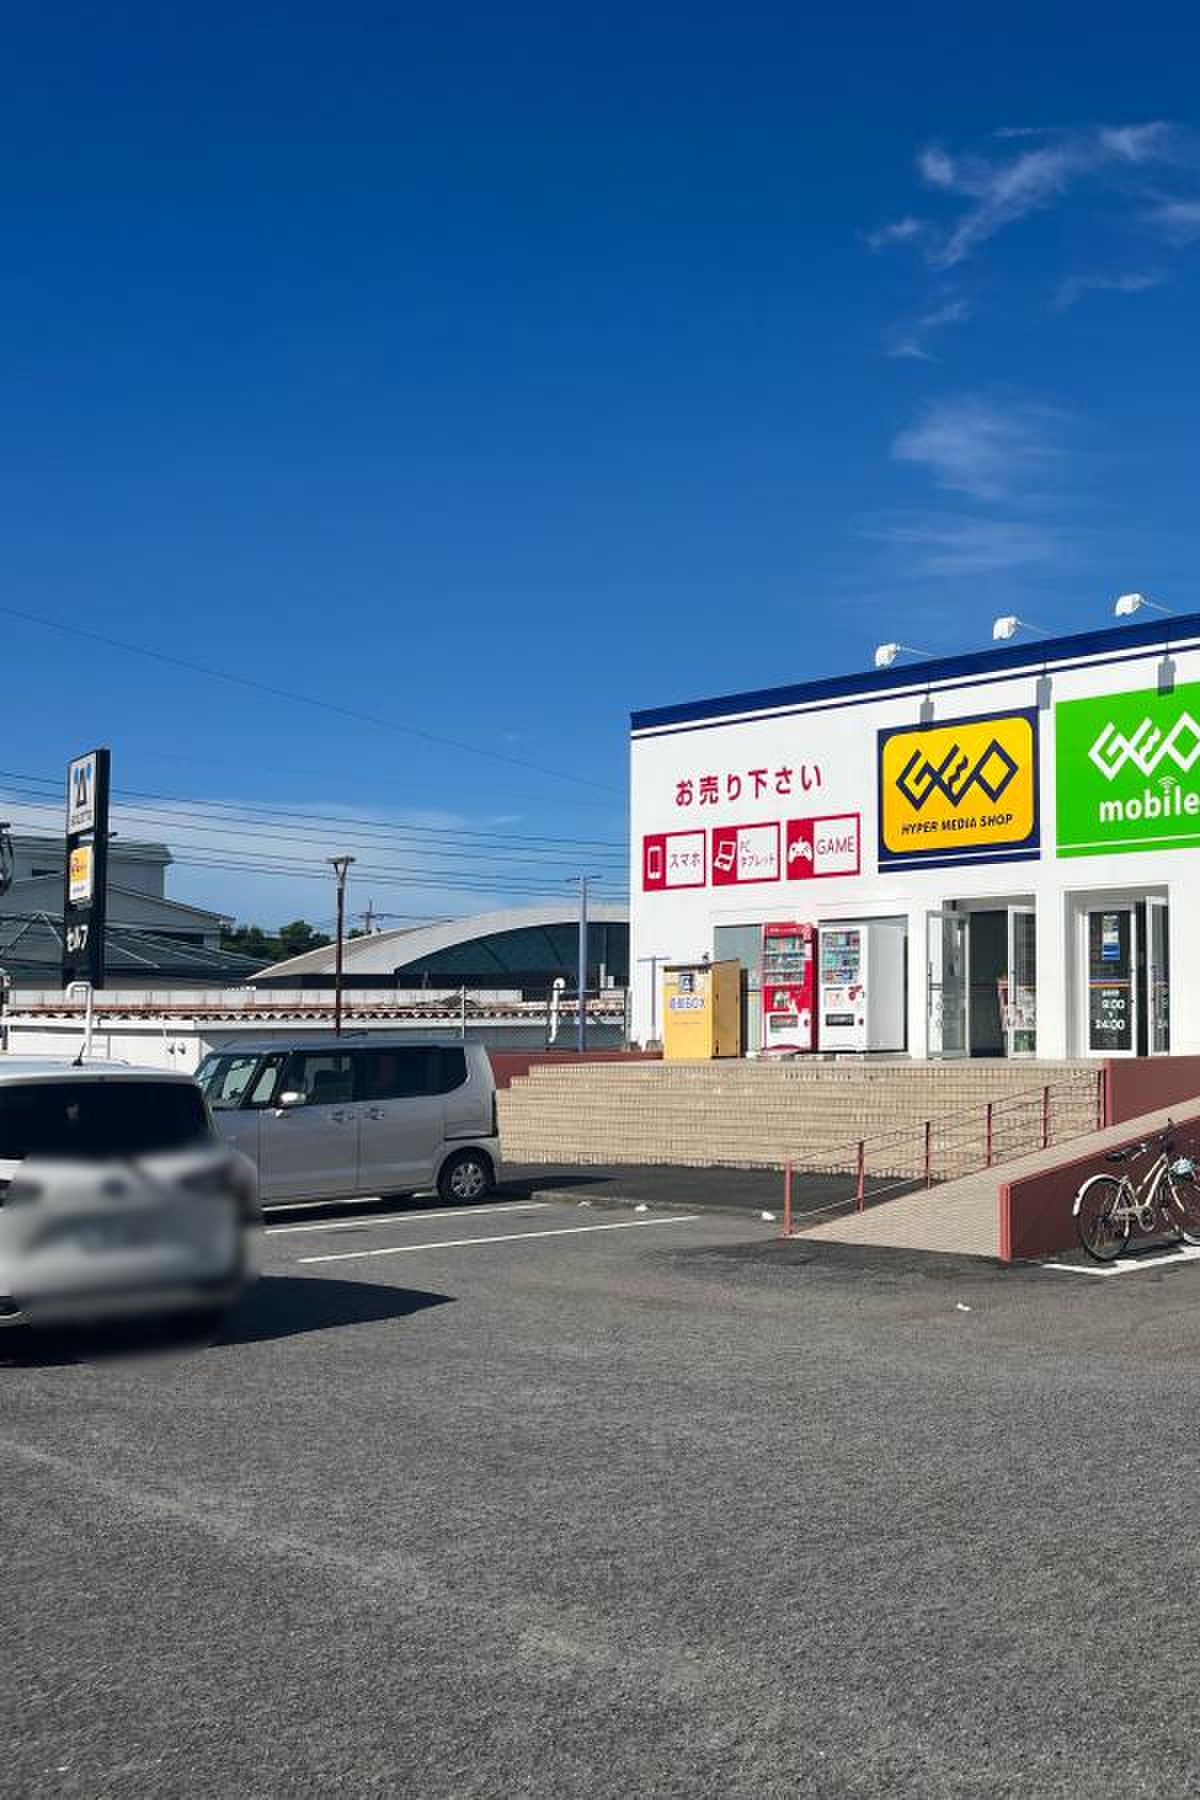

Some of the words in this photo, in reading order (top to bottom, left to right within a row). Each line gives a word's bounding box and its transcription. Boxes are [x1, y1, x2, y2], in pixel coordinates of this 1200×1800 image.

[675, 764, 822, 807] お売り下さい
[896, 738, 1019, 811] GEO
[1099, 785, 1200, 823] mobile
[901, 819, 938, 836] HYPER
[941, 817, 977, 831] MEDIA
[979, 813, 1013, 828] SHOP
[669, 852, 702, 869] スマホ
[816, 835, 855, 856] GAME
